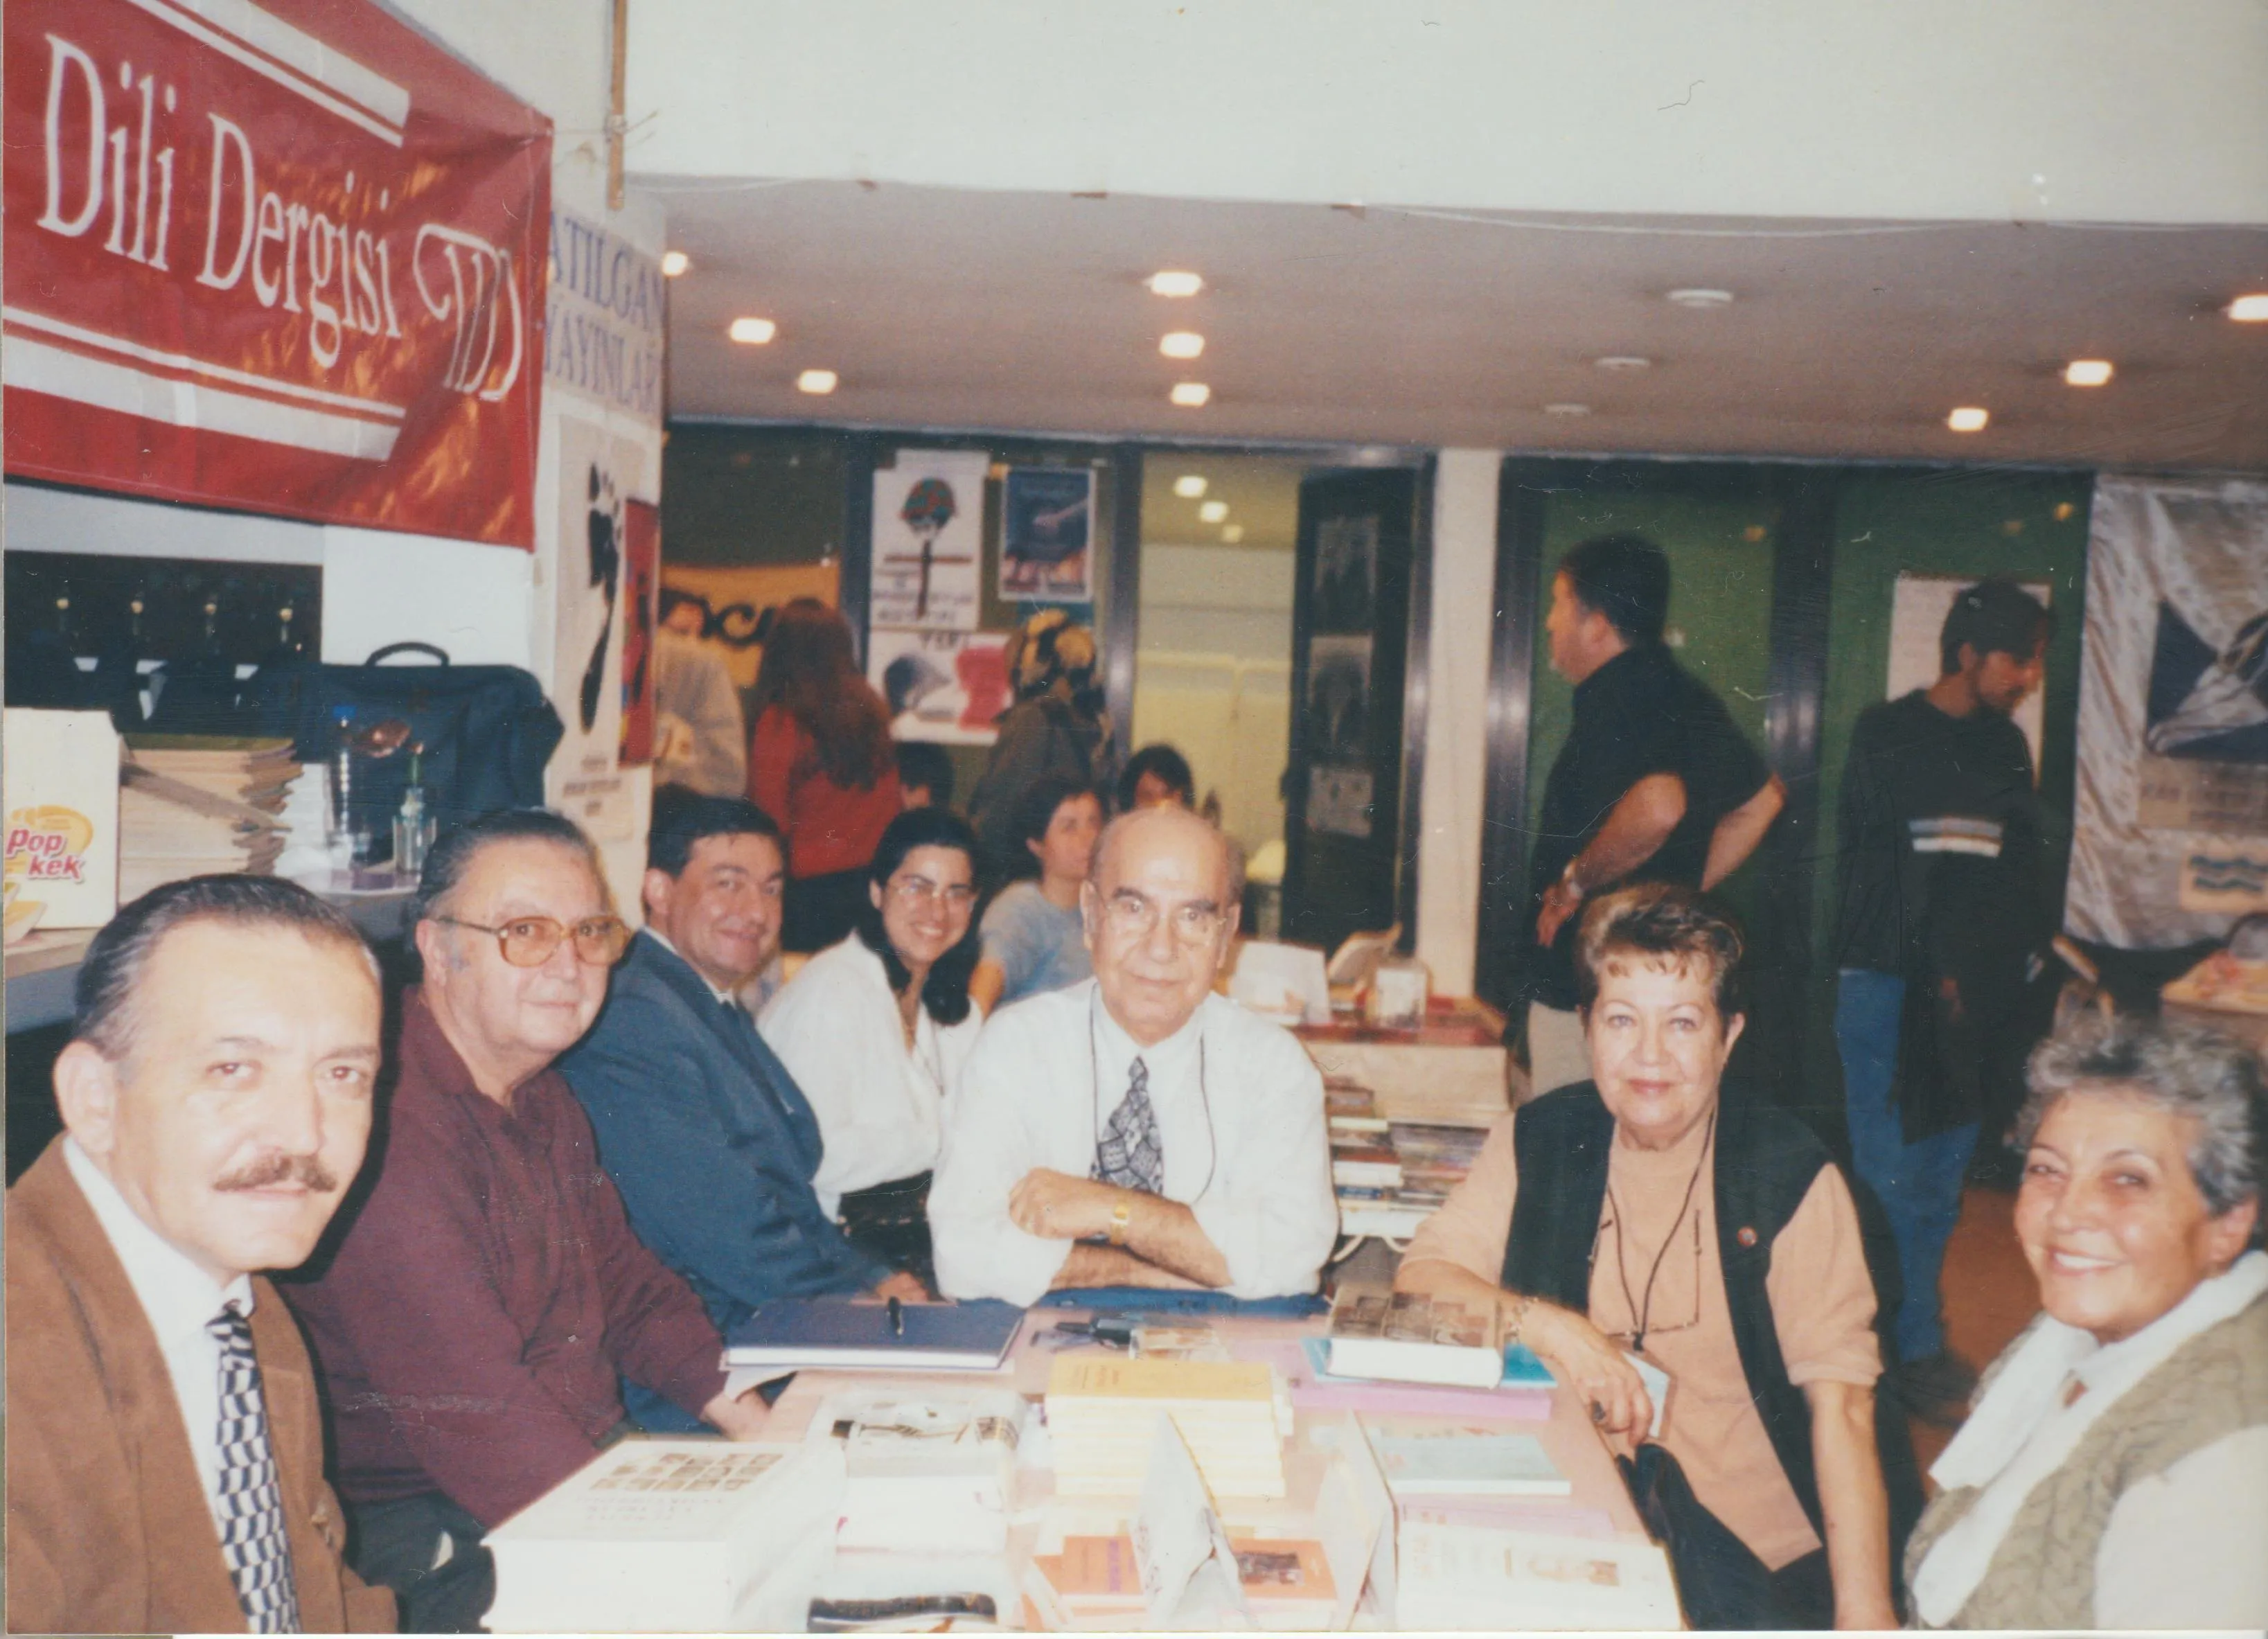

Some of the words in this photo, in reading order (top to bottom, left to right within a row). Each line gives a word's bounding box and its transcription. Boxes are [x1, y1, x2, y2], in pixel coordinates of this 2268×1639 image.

[37, 33, 176, 272] Dili
[196, 112, 402, 369] Dergisi
[28, 854, 80, 880] kek
